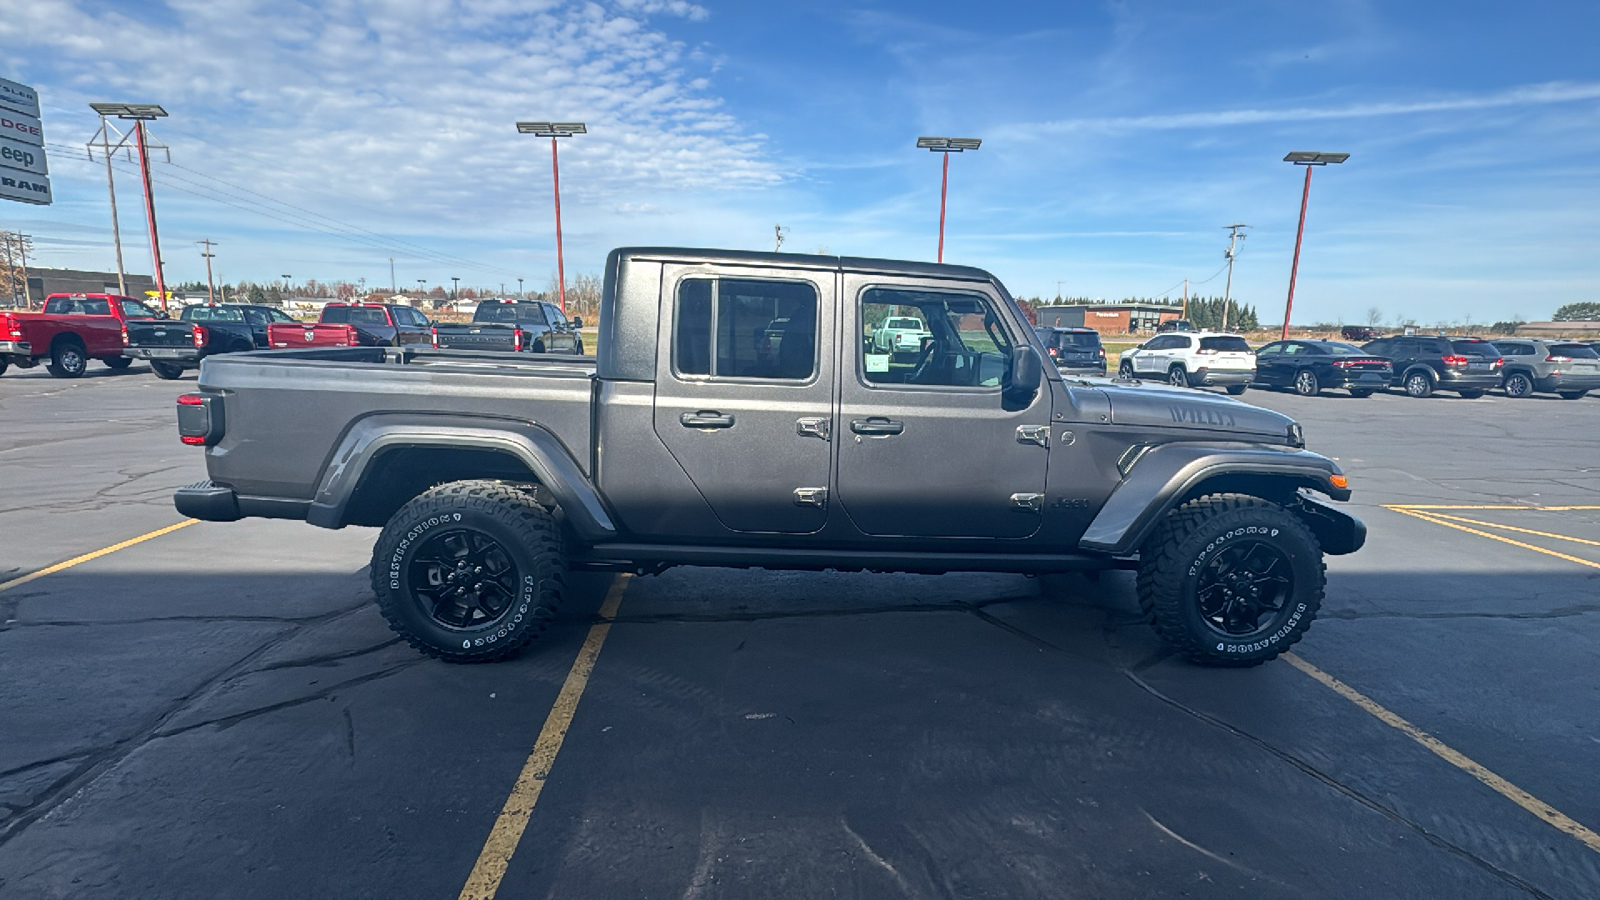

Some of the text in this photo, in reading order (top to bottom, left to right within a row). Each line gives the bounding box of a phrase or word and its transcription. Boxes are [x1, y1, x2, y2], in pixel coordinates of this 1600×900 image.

[0, 84, 33, 100] SLER
[1, 176, 48, 194] RAM
[390, 514, 451, 590] DESTINATION
[1227, 602, 1307, 653] DESTINATION
